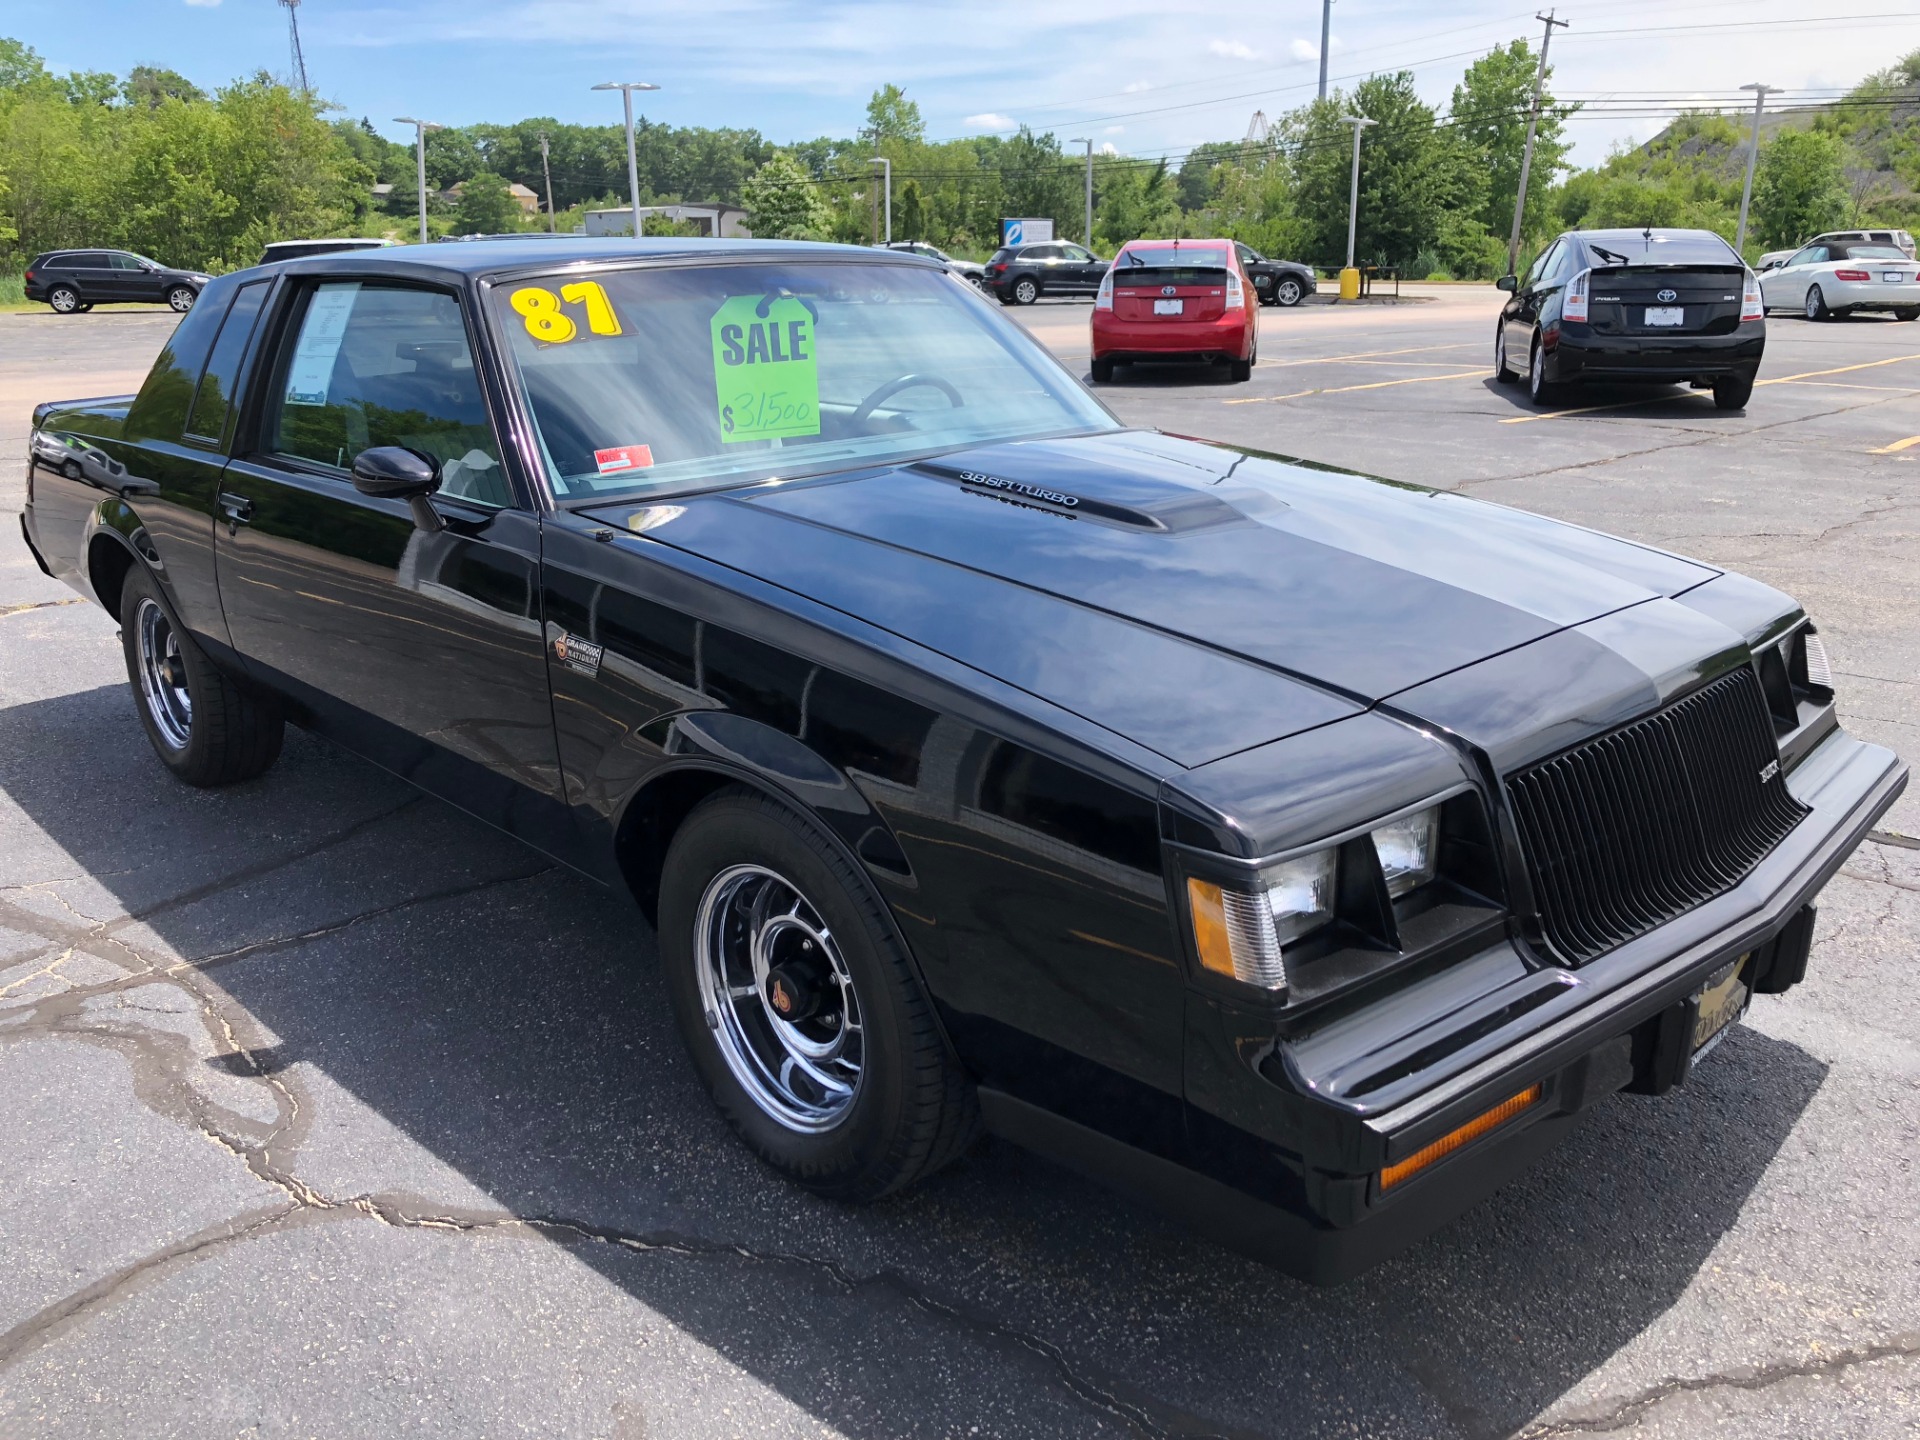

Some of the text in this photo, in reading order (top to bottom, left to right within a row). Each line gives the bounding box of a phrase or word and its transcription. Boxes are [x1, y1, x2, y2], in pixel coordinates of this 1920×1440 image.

[510, 281, 622, 342] 87
[720, 320, 808, 367] SALE
[1016, 483, 1079, 506] TURBO
[566, 638, 587, 652] GRAND
[568, 650, 597, 666] NATIONAL
